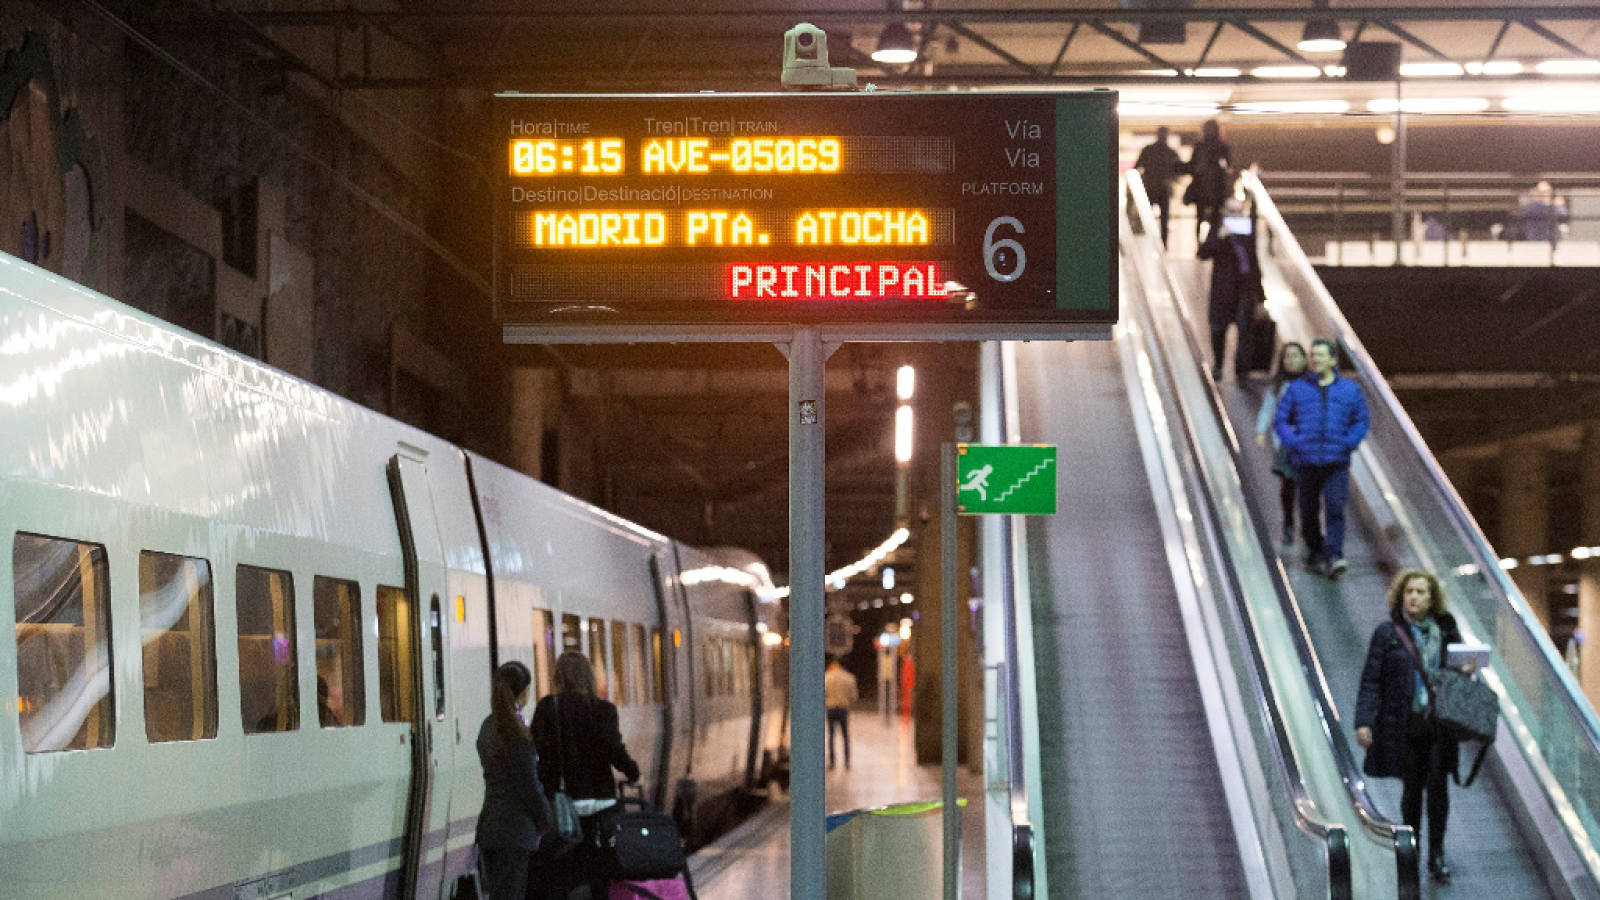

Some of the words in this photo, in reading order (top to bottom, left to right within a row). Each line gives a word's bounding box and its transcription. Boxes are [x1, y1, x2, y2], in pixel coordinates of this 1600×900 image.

[1004, 119, 1041, 139] Vía
[513, 141, 622, 173] 06:15
[644, 139, 841, 173] AVE-05069
[1004, 147, 1040, 168] Via
[962, 182, 1043, 195] PLATFORM
[535, 213, 665, 245] MADRID
[687, 212, 770, 245] PTA.
[796, 211, 928, 244] ATOCHA
[983, 216, 1027, 282] 6
[732, 265, 949, 298] PRINCIPAL
